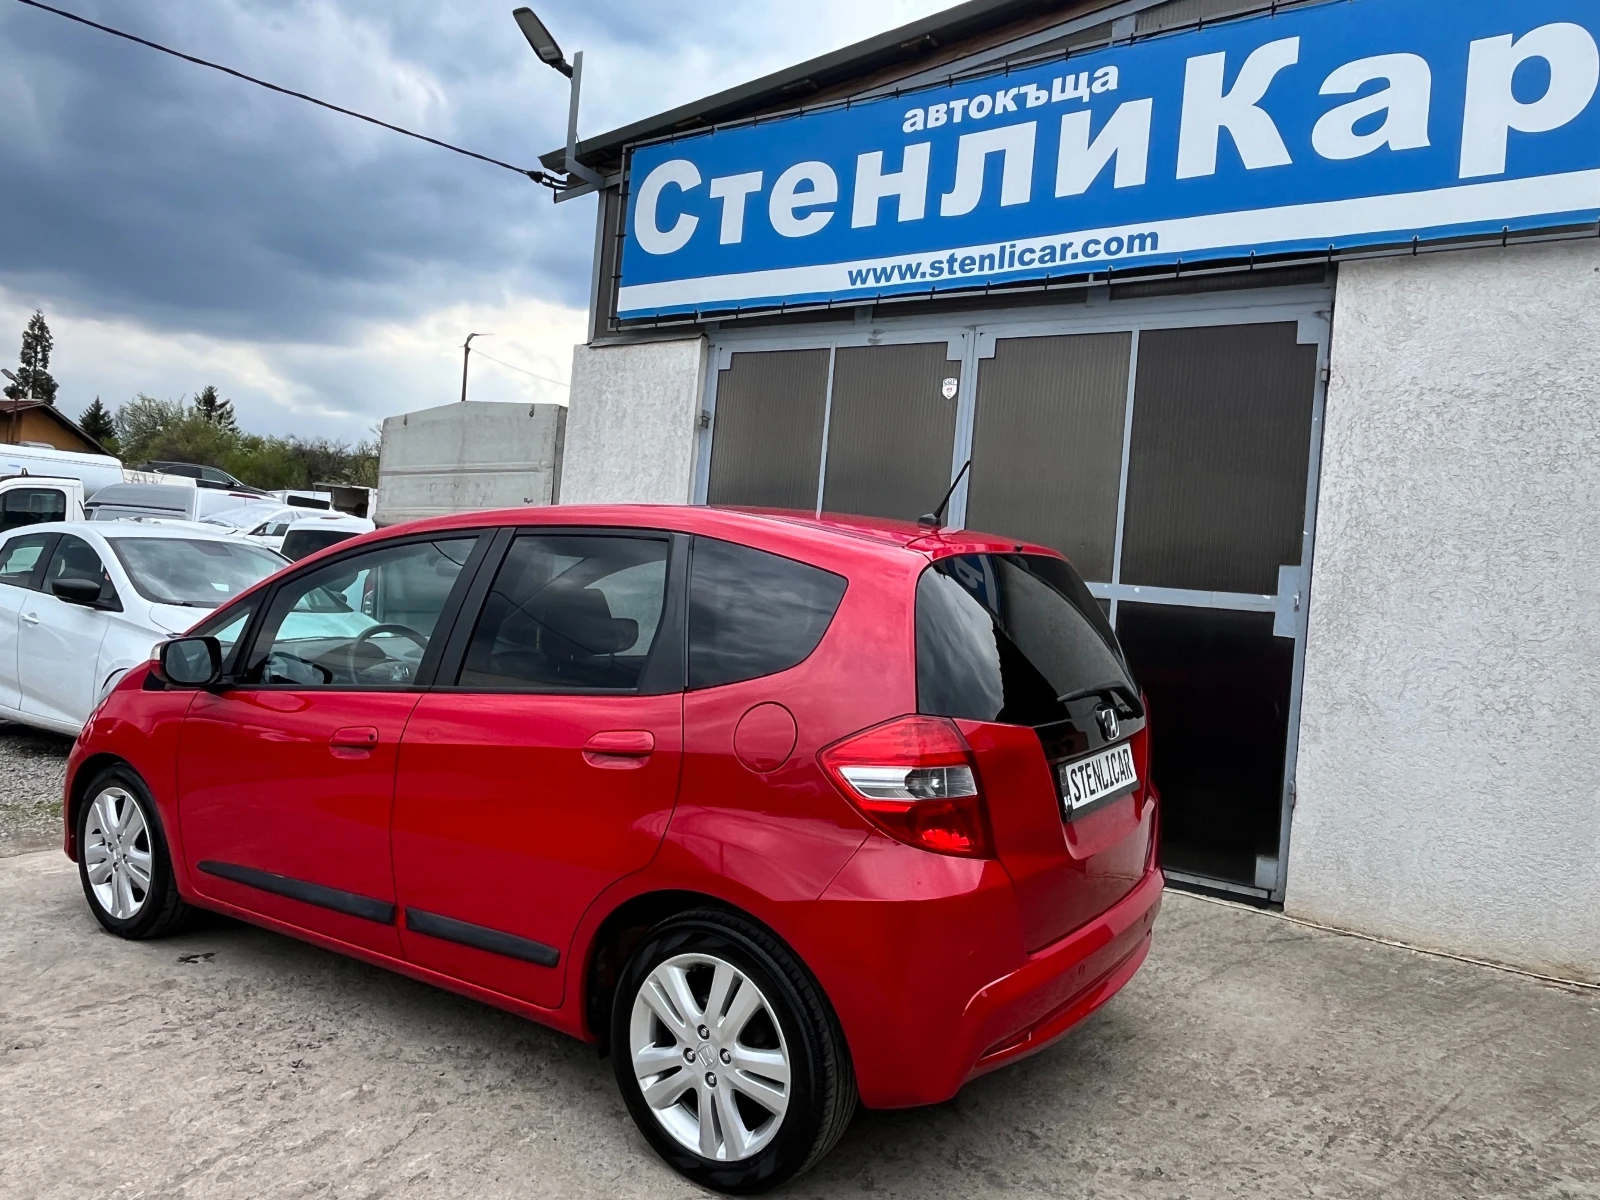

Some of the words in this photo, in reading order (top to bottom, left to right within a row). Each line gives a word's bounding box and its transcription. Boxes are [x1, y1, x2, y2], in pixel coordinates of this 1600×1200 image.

[902, 65, 1119, 134] автокъща
[847, 231, 1159, 287] www.stenlicar.com
[1070, 748, 1133, 802] STENLICAR
